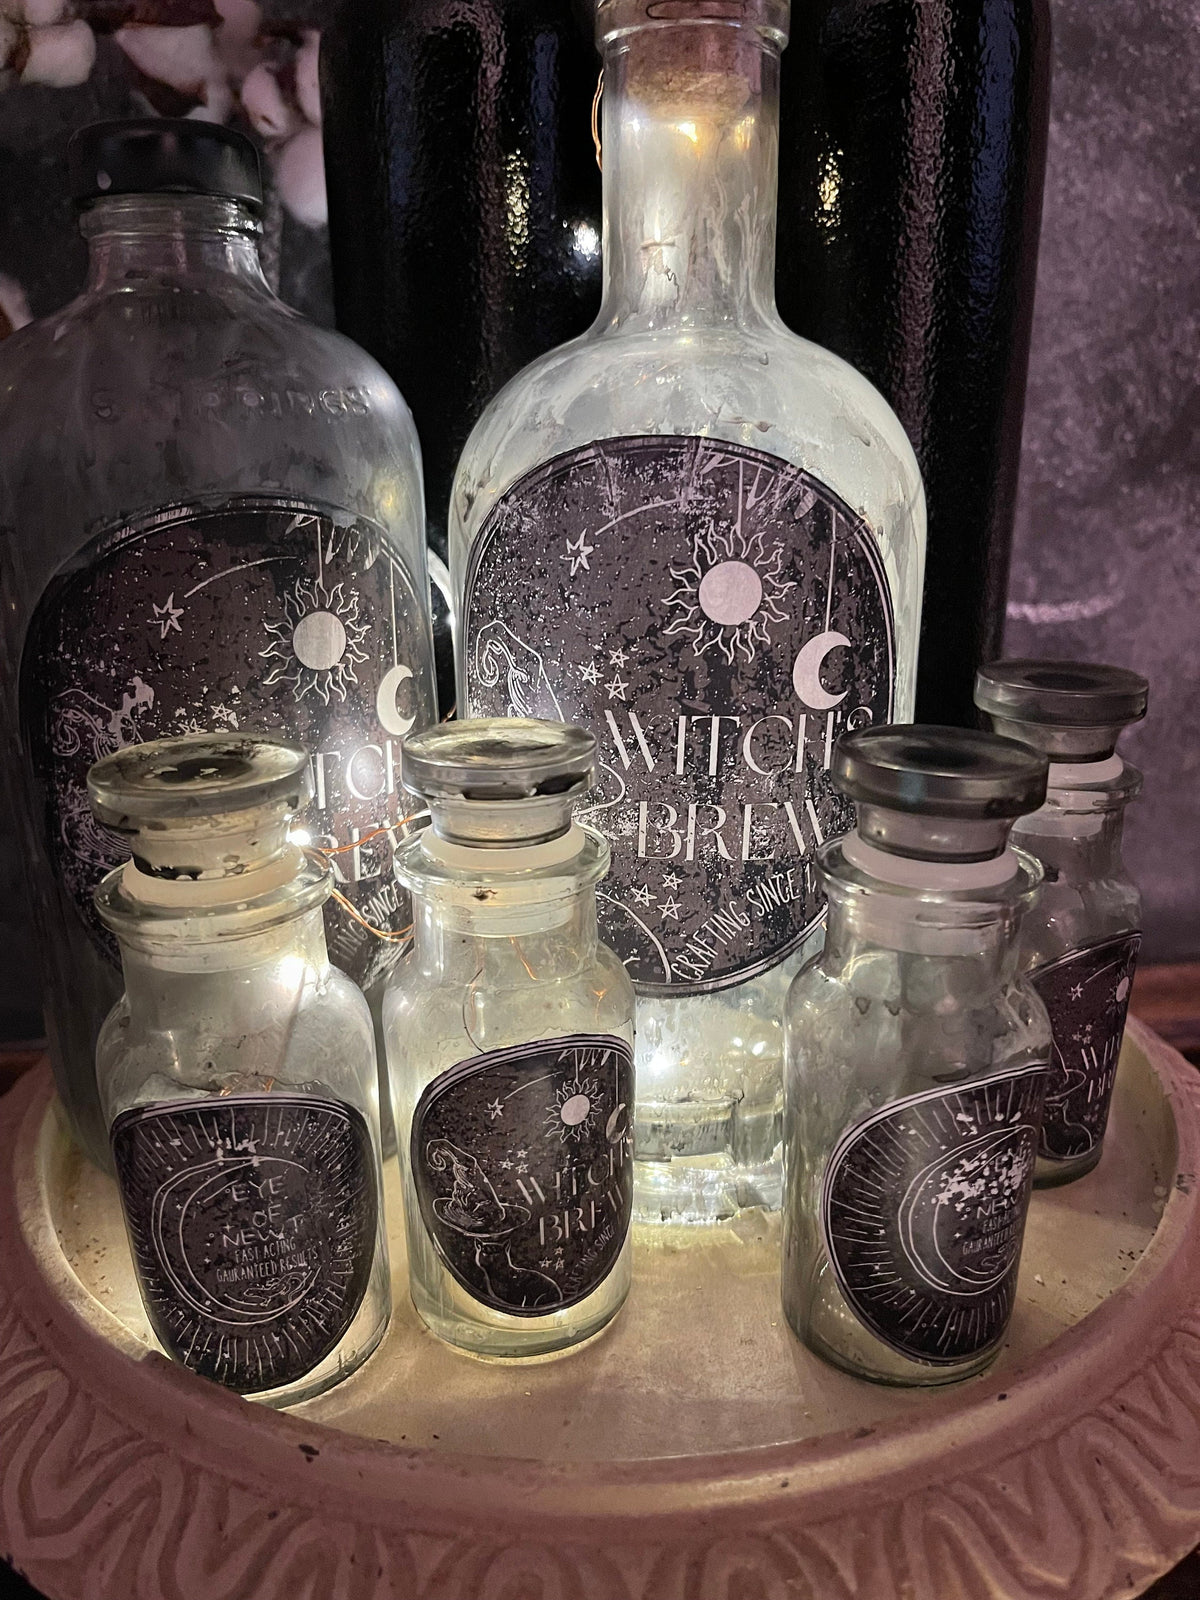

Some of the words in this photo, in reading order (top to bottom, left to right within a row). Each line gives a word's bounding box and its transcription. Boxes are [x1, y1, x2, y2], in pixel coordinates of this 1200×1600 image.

[361, 879, 404, 927] SINCE
[670, 900, 751, 982] CRAFTING
[746, 867, 801, 917] SINCE
[232, 1175, 284, 1202] EYE
[222, 1213, 304, 1248] NEWT
[253, 1204, 282, 1228] OF
[263, 1236, 297, 1260] ACTING
